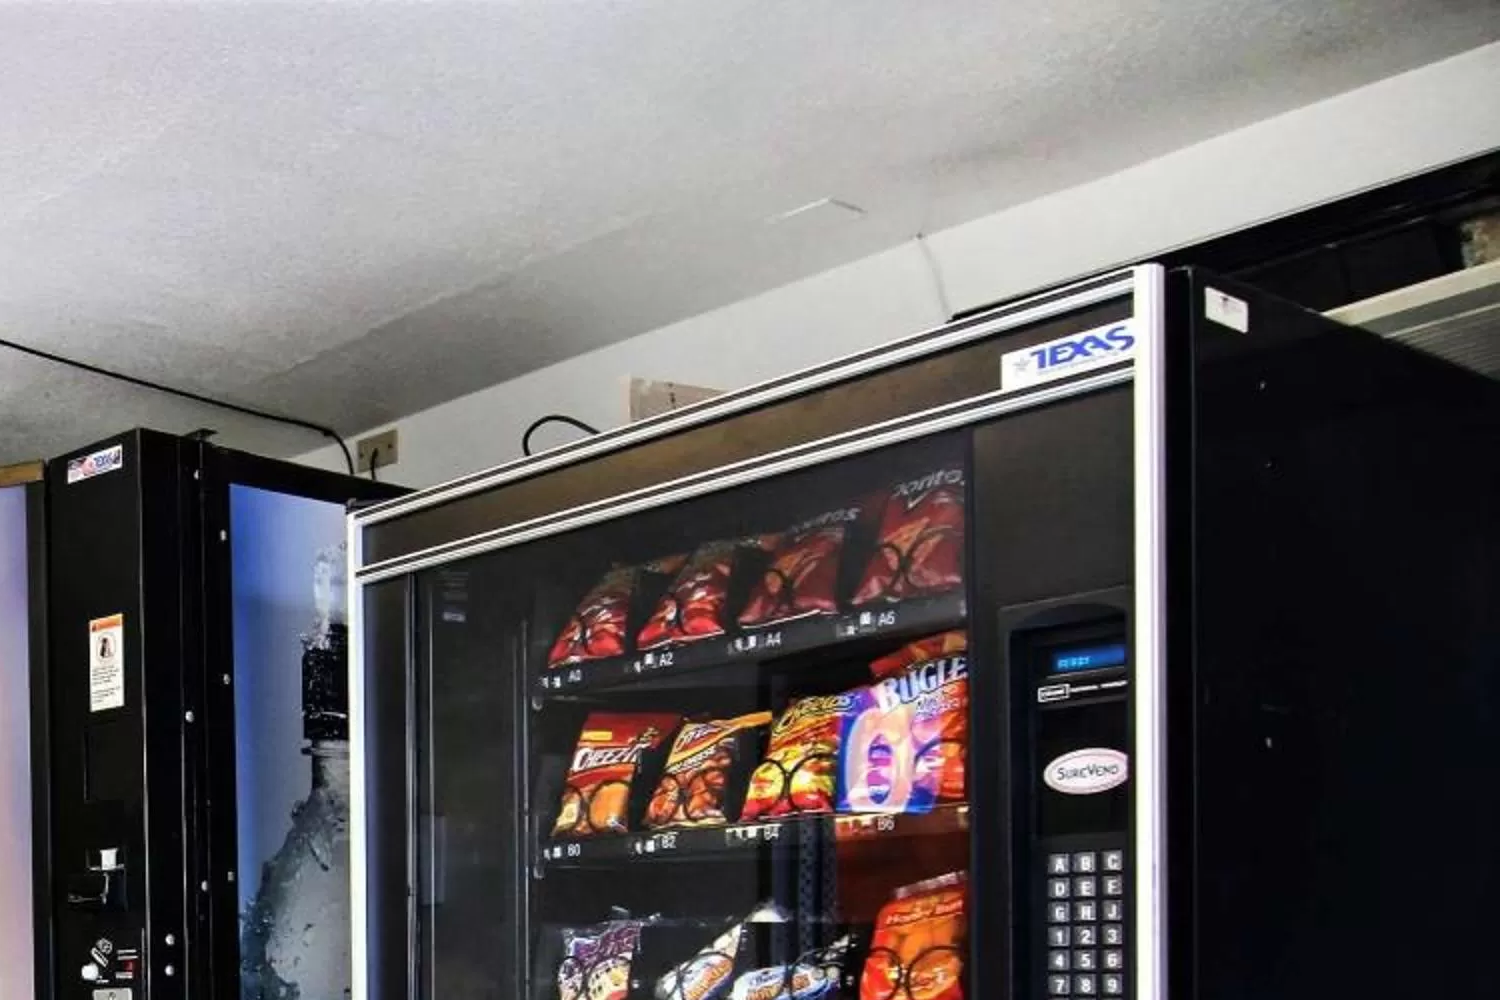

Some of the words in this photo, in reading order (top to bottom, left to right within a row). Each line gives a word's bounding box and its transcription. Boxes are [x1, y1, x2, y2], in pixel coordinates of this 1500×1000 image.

[1030, 326, 1135, 369] TEXAS
[659, 652, 674, 667] A2
[1054, 857, 1066, 870] A
[1080, 855, 1091, 870] B
[1107, 854, 1118, 867] C
[1054, 883, 1066, 895] D
[1080, 881, 1091, 895] E
[1107, 880, 1118, 893] F
[1054, 930, 1066, 943] 1
[1080, 930, 1091, 943] 2
[1107, 929, 1118, 942] 3
[1054, 954, 1066, 967] 4
[1080, 954, 1091, 967] 5
[1107, 953, 1118, 966] 6
[1054, 979, 1066, 992] 7
[1080, 979, 1091, 992] 8
[1107, 978, 1118, 991] 9
